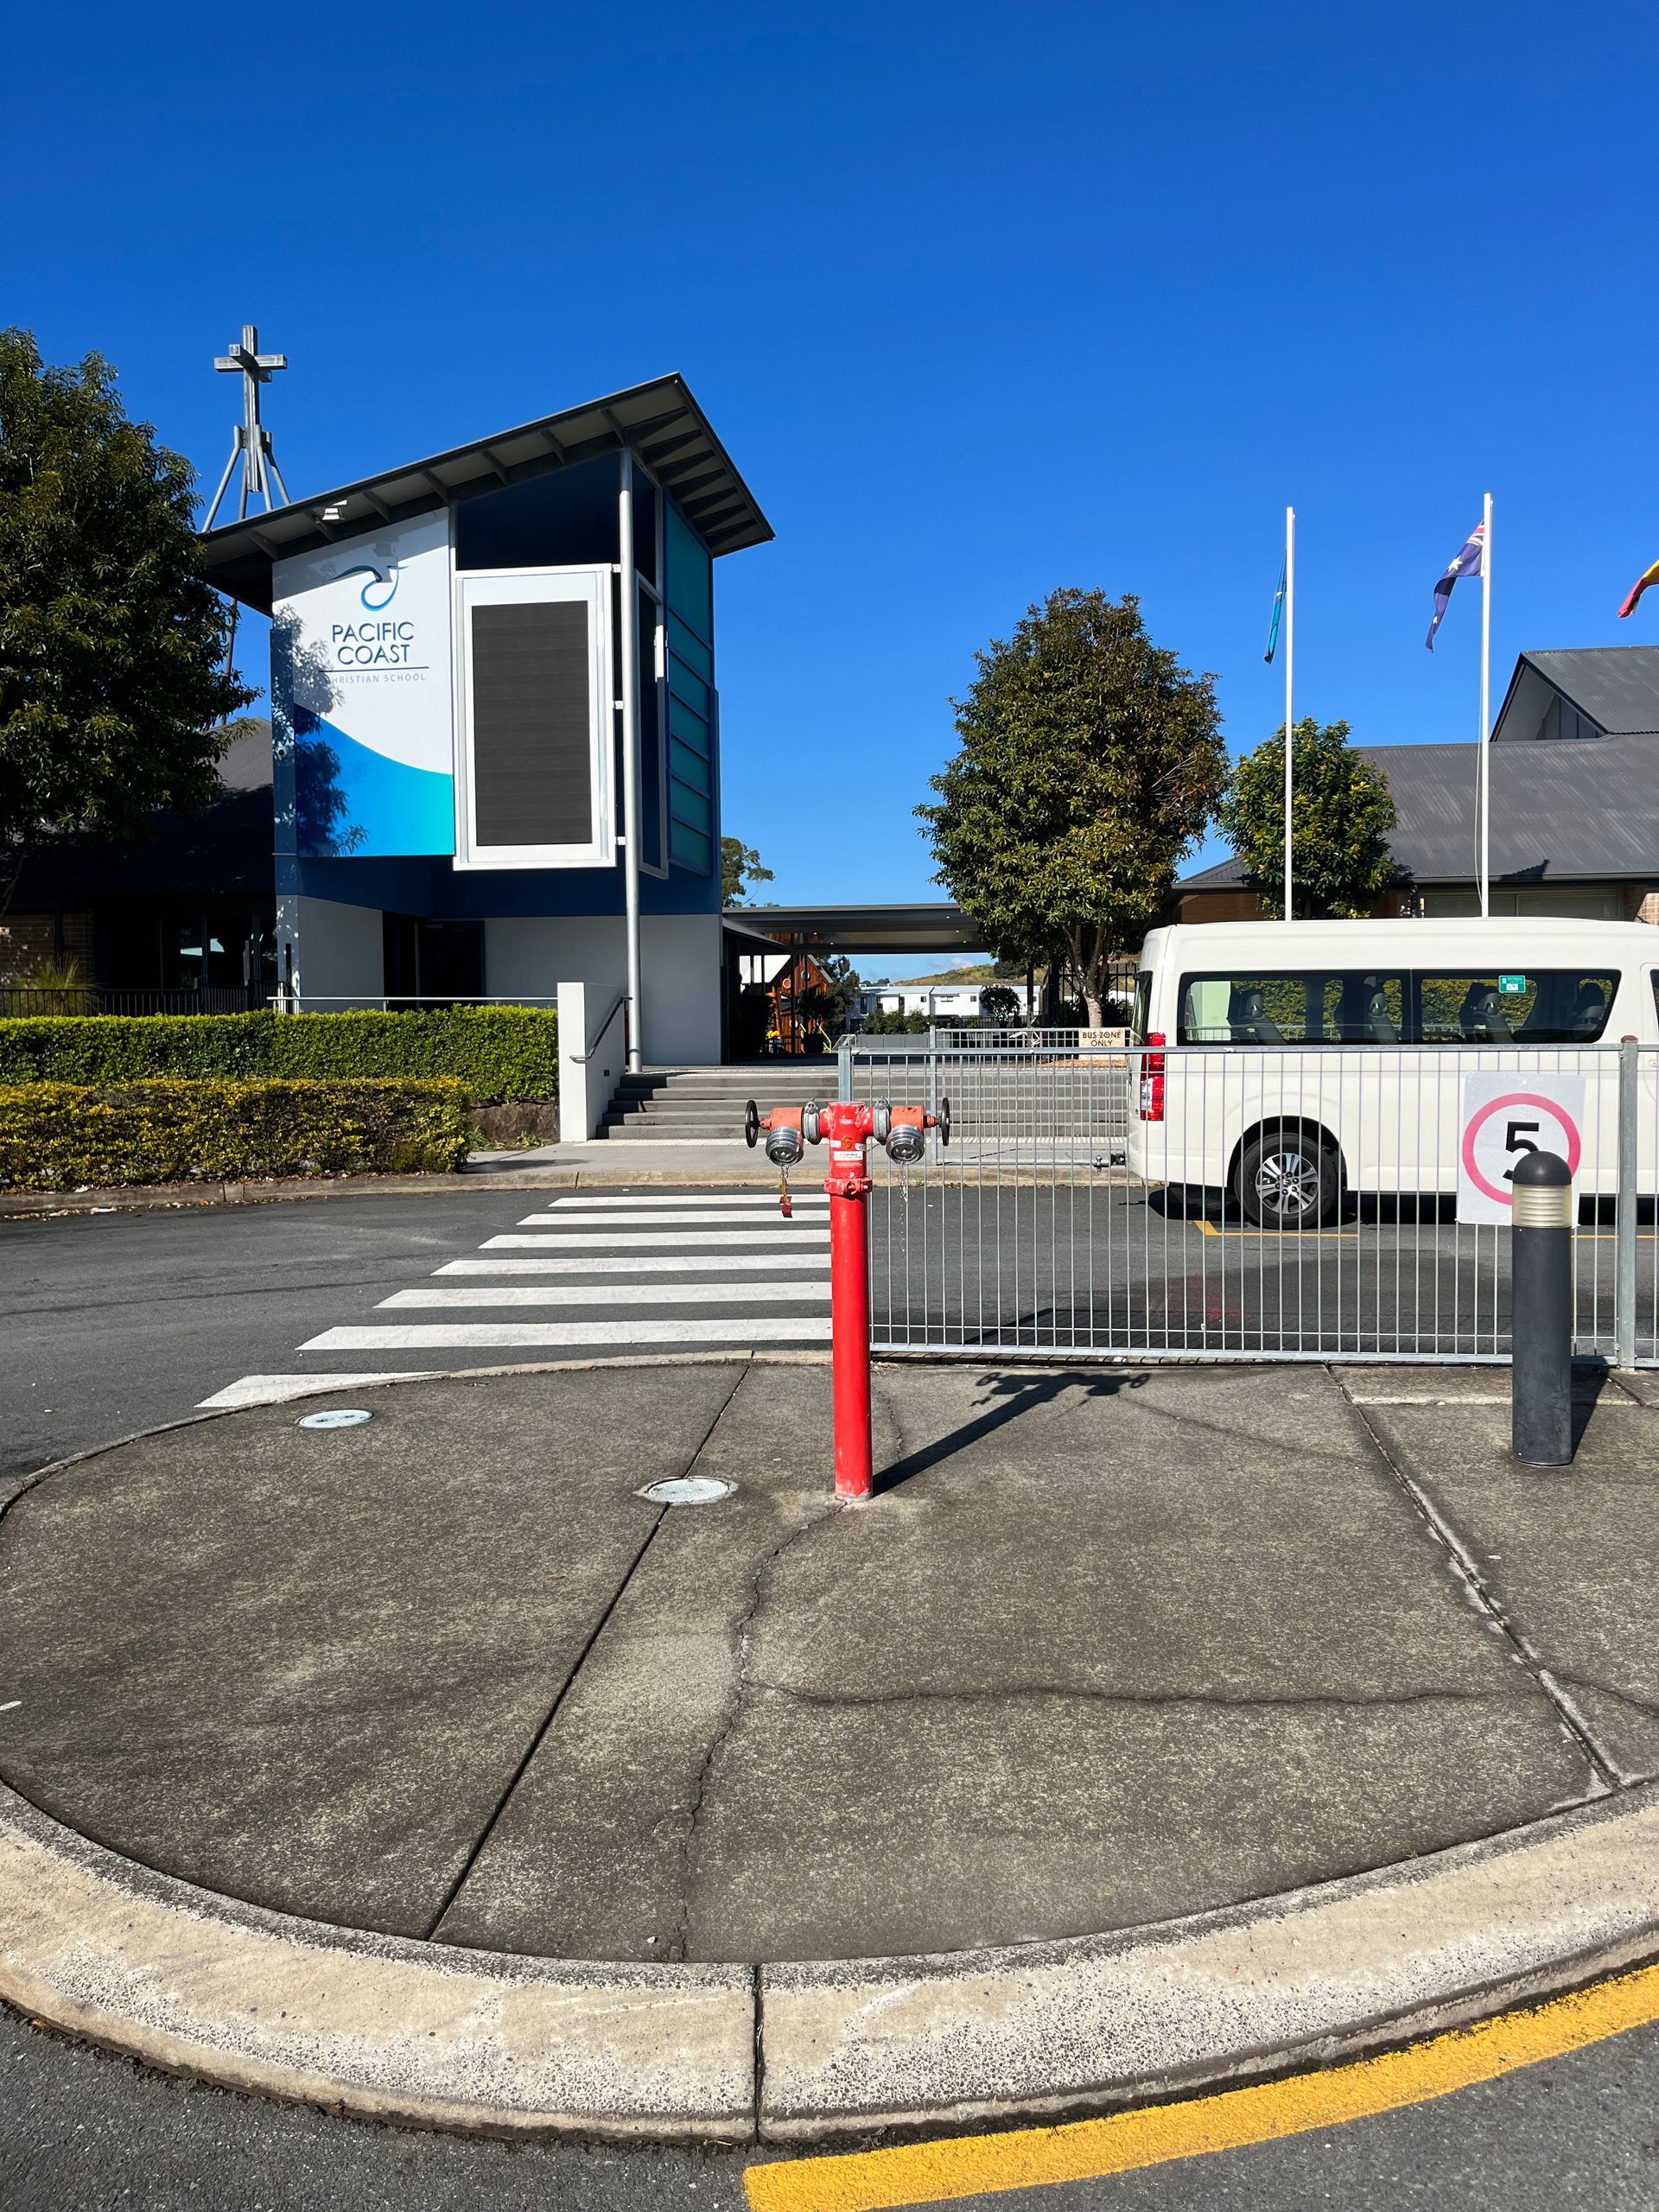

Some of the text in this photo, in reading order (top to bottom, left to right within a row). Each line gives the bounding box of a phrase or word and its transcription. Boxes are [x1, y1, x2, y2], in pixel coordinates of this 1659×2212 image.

[332, 621, 415, 643] PACIFIC
[337, 644, 410, 665] COAST
[384, 673, 426, 683] SCHOOL
[1503, 1121, 1540, 1181] 5
